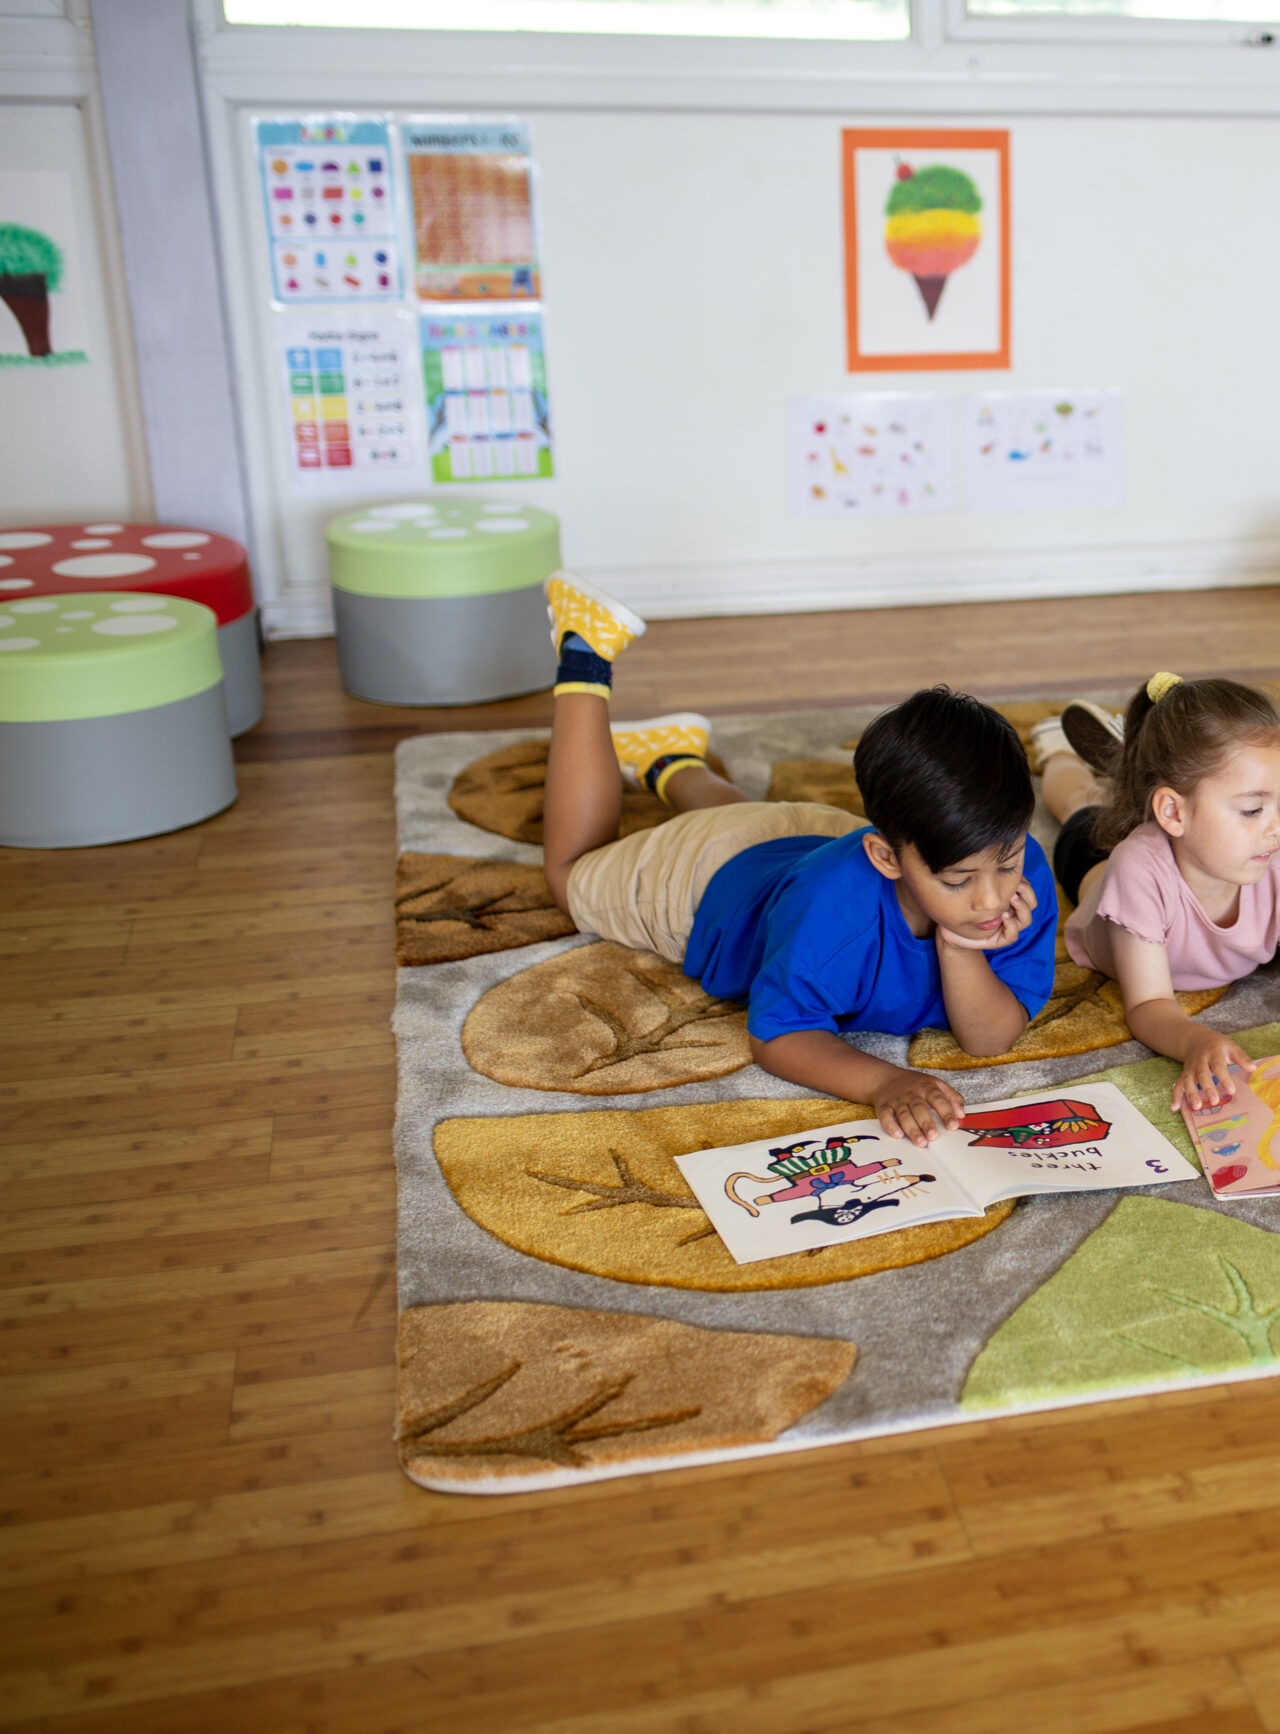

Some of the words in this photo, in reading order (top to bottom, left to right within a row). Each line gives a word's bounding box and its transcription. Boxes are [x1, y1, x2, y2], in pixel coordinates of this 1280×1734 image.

[1007, 1146, 1103, 1161] buckles
[1031, 1162, 1102, 1171] three
[1145, 1159, 1169, 1173] 3
